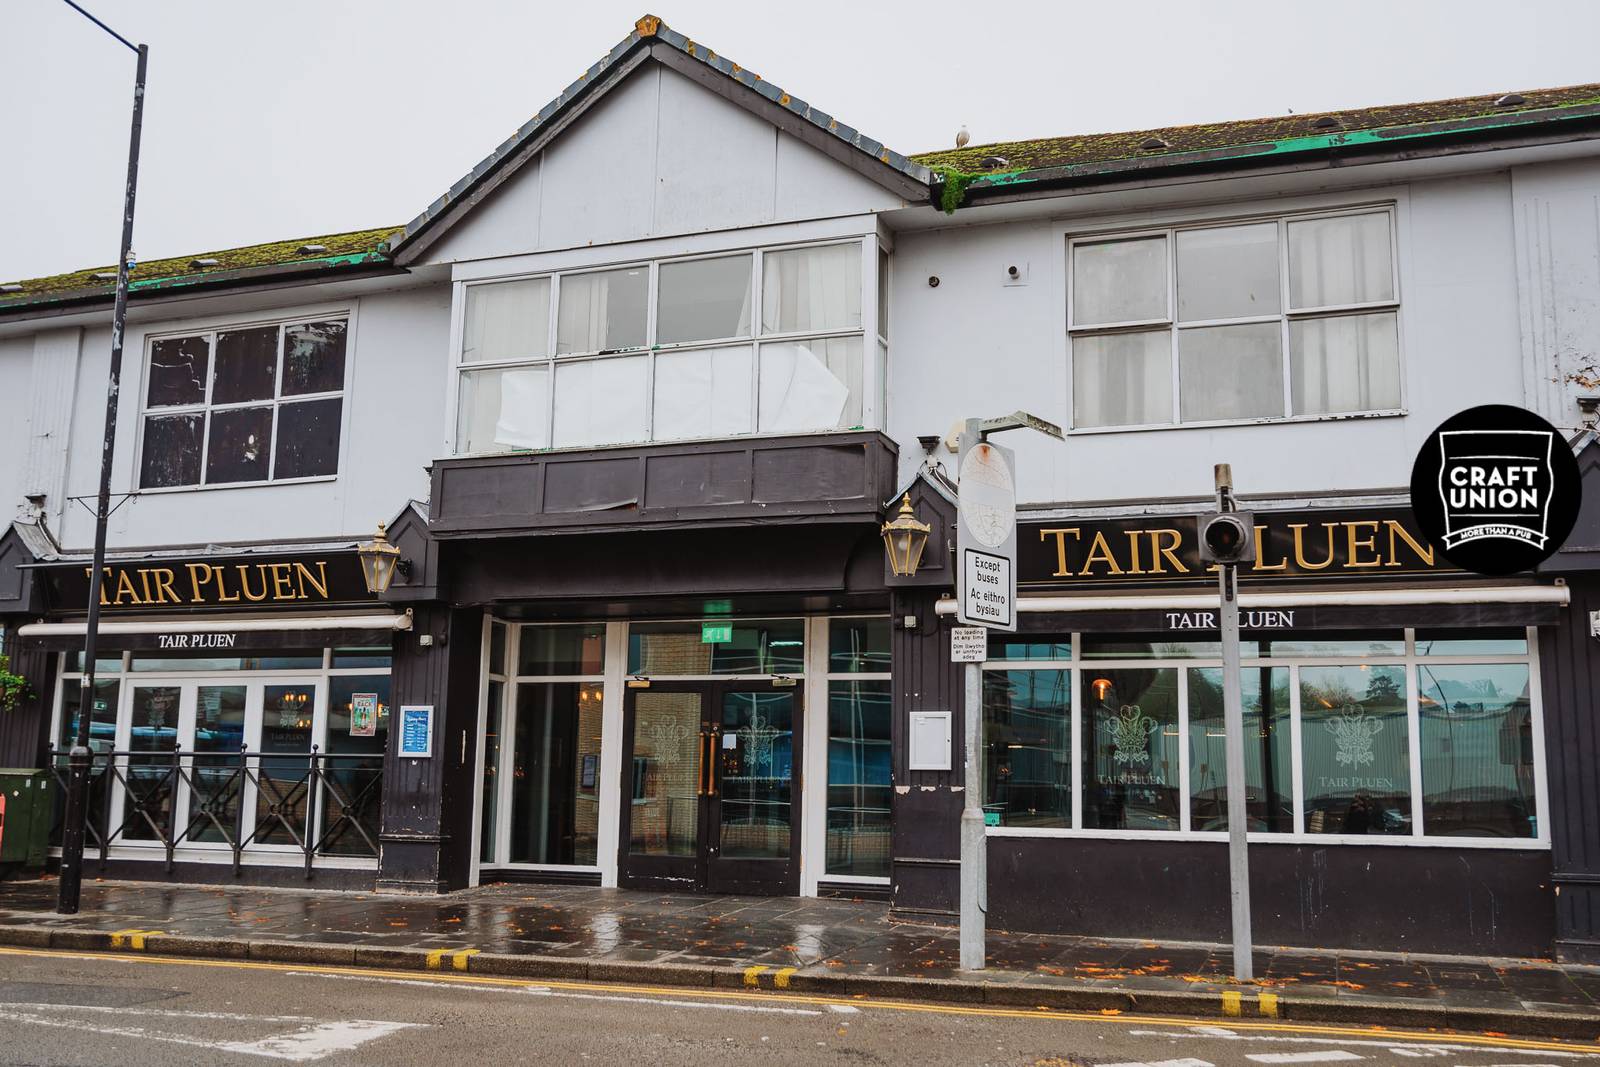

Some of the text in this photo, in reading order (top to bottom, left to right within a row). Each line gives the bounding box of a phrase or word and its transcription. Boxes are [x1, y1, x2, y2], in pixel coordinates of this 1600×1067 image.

[1039, 519, 1434, 577] TAIR LUEN
[975, 556, 1001, 572] Except
[86, 561, 328, 605] TAIR PLUEN
[977, 571, 999, 585] buses
[970, 587, 1006, 605] Ac eithro
[976, 602, 1000, 617] bysiau
[1166, 611, 1295, 629] TAIR LUEN
[159, 634, 237, 648] TAIR PLUEN
[1097, 774, 1124, 785] TAIR
[1318, 776, 1393, 788] TAIR PLUEN
